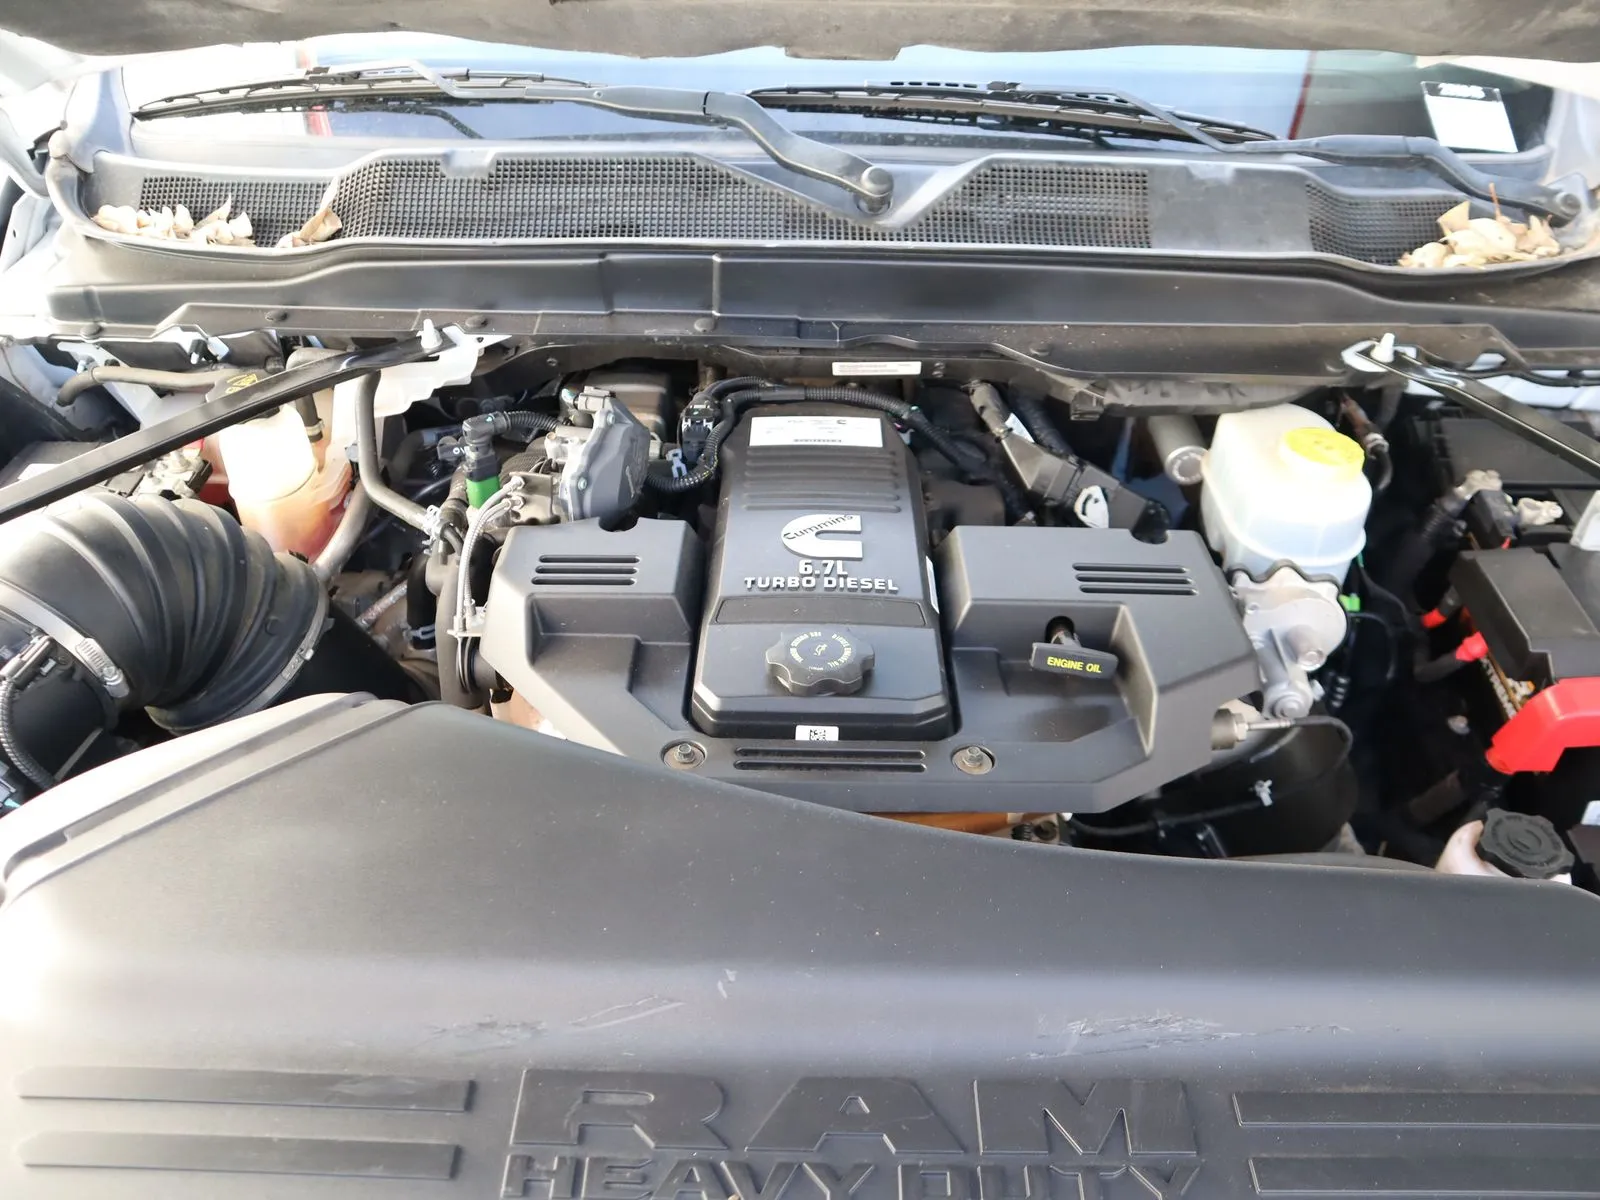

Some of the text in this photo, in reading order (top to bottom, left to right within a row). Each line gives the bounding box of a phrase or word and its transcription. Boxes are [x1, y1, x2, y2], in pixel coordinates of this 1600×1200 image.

[783, 514, 854, 540] Cummins
[798, 559, 849, 577] 6.7L
[744, 576, 899, 594] TURBO DIESEL
[1046, 656, 1103, 674] ENGINE OIL
[509, 1069, 1199, 1156] RAM
[499, 1153, 1201, 1200] HEAVY DUTY
